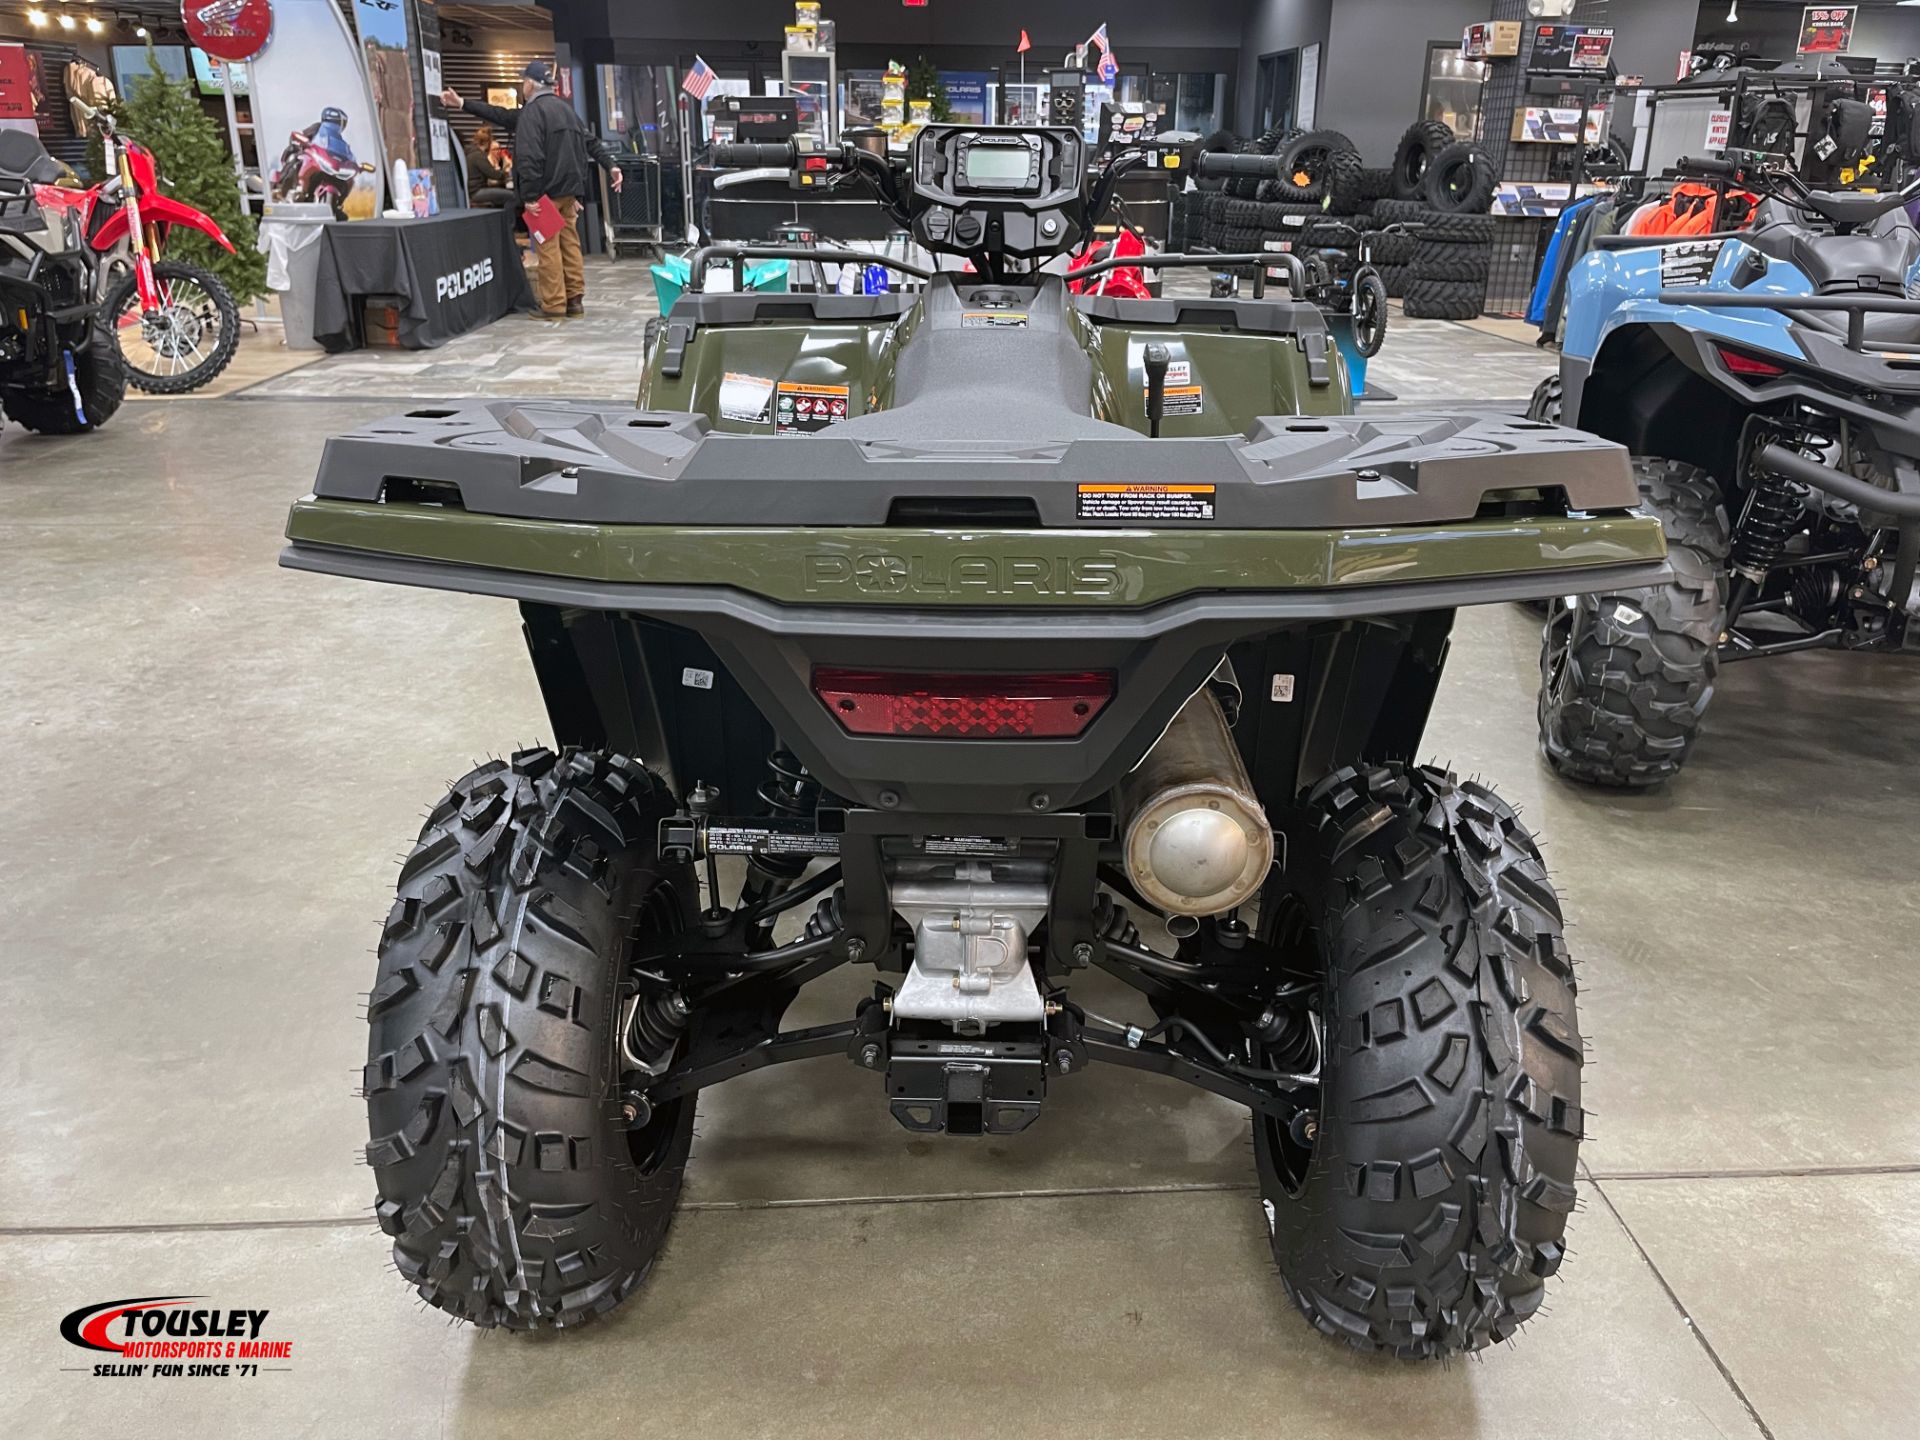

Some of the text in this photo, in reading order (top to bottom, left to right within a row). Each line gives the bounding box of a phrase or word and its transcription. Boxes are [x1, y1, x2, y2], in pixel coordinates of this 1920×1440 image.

[1811, 10, 1848, 21] 15% OFF
[1696, 42, 1735, 51] ski-doo
[436, 257, 494, 303] POLARIS
[804, 554, 1122, 595] POLARIS
